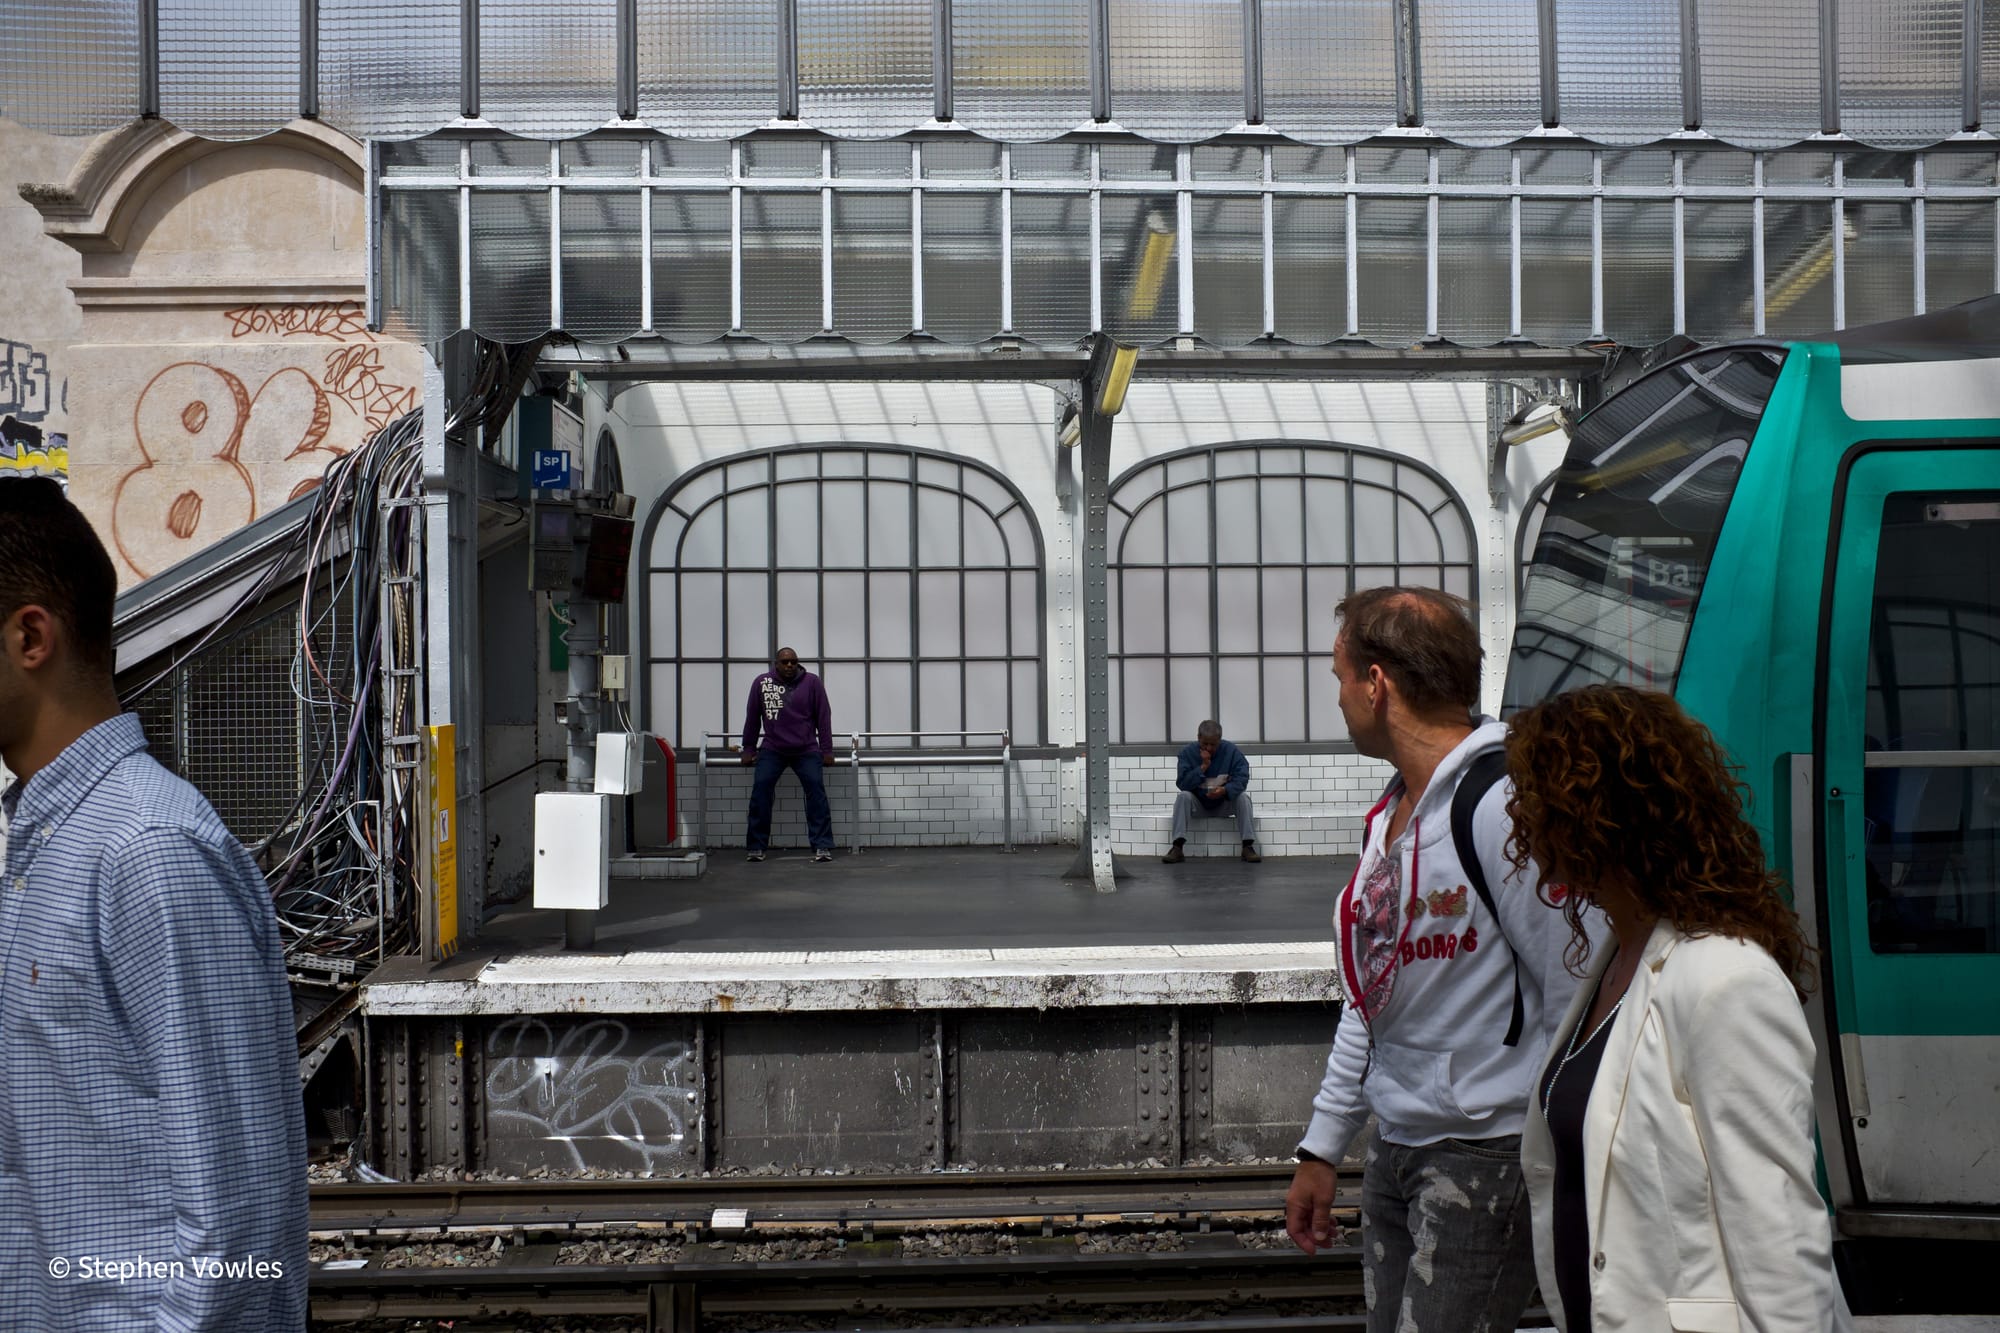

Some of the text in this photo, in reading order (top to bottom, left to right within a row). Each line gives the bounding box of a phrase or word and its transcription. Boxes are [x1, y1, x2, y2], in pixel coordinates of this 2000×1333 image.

[543, 456, 560, 467] SP
[762, 683, 786, 694] AERO
[764, 692, 781, 701] POS
[764, 699, 784, 709] TALE
